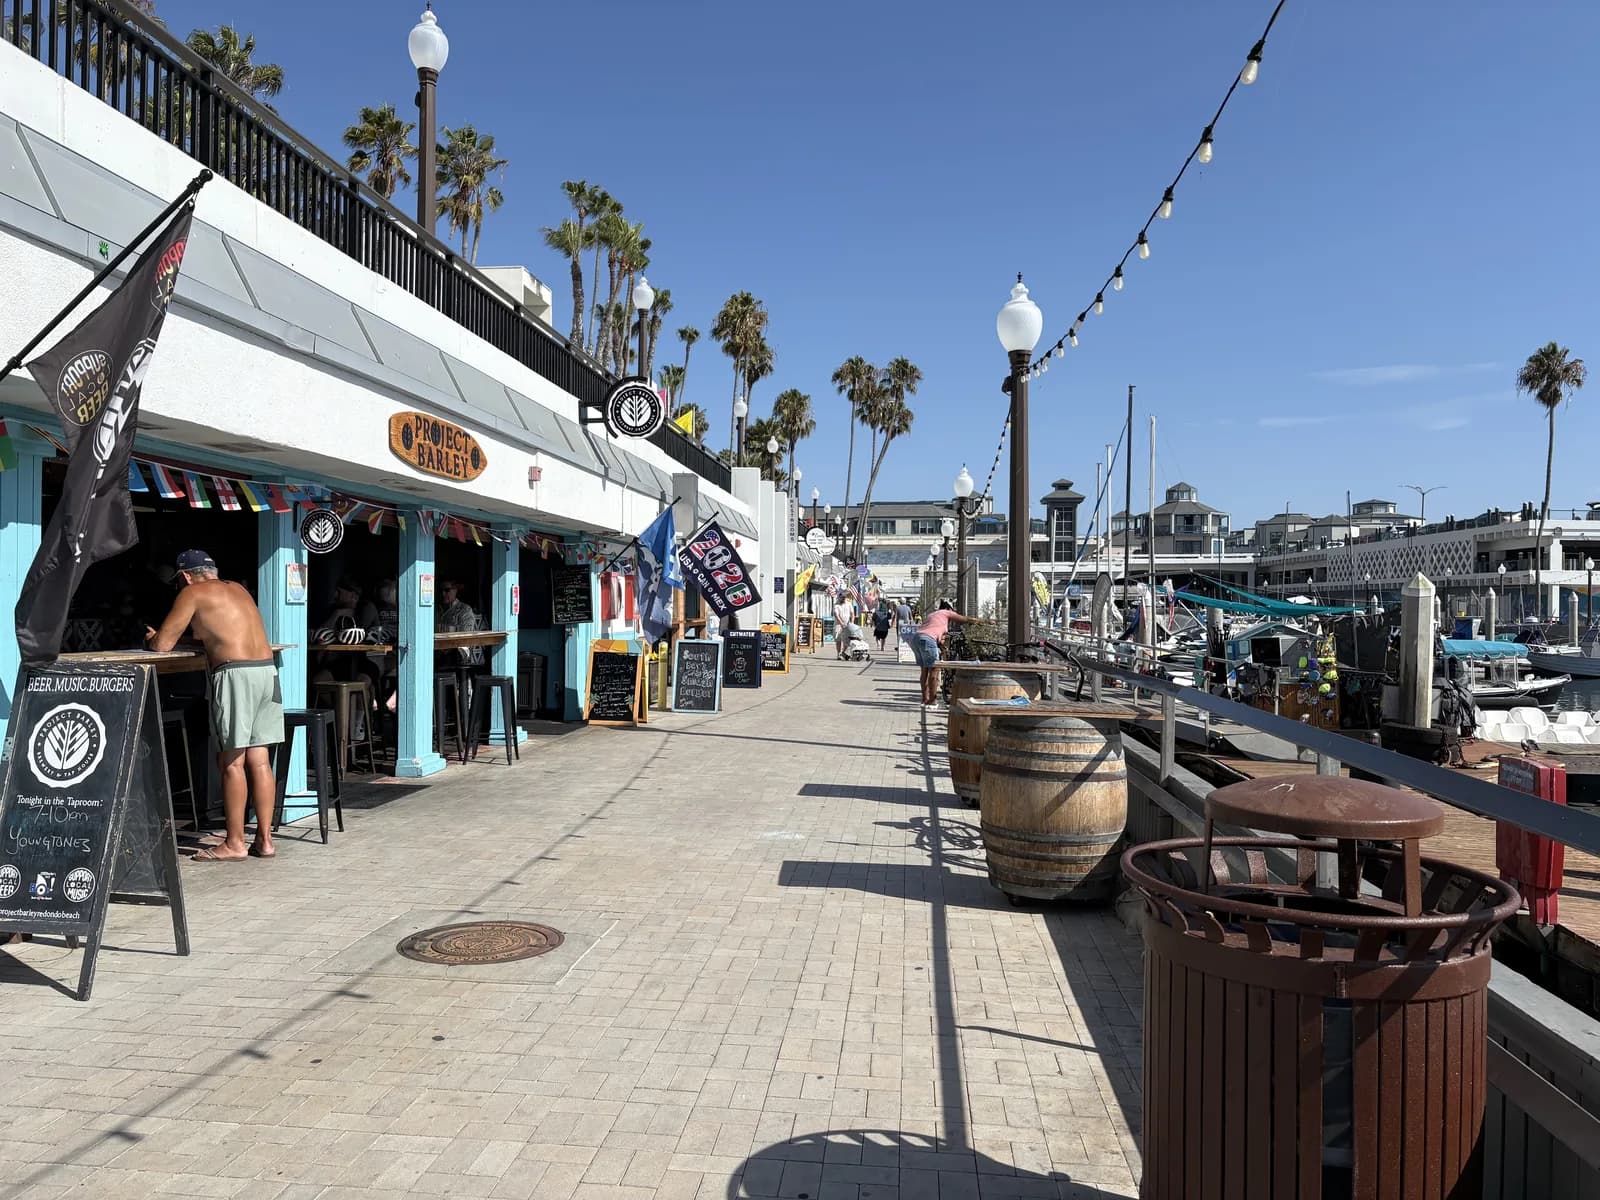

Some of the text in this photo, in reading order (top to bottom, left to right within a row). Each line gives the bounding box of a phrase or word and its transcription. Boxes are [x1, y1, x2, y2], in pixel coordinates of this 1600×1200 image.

[415, 415, 471, 454] PROJECT
[417, 442, 468, 478] BARLEY
[689, 529, 753, 607] 2026
[679, 553, 727, 611] USA CAN MEX
[40, 711, 98, 738] PROJECT BARLEY
[17, 795, 42, 806] Tonight
[67, 797, 104, 808] Taproom:
[68, 869, 93, 882] SUPPORT
[0, 884, 15, 897] EER
[67, 888, 89, 900] MUSIC
